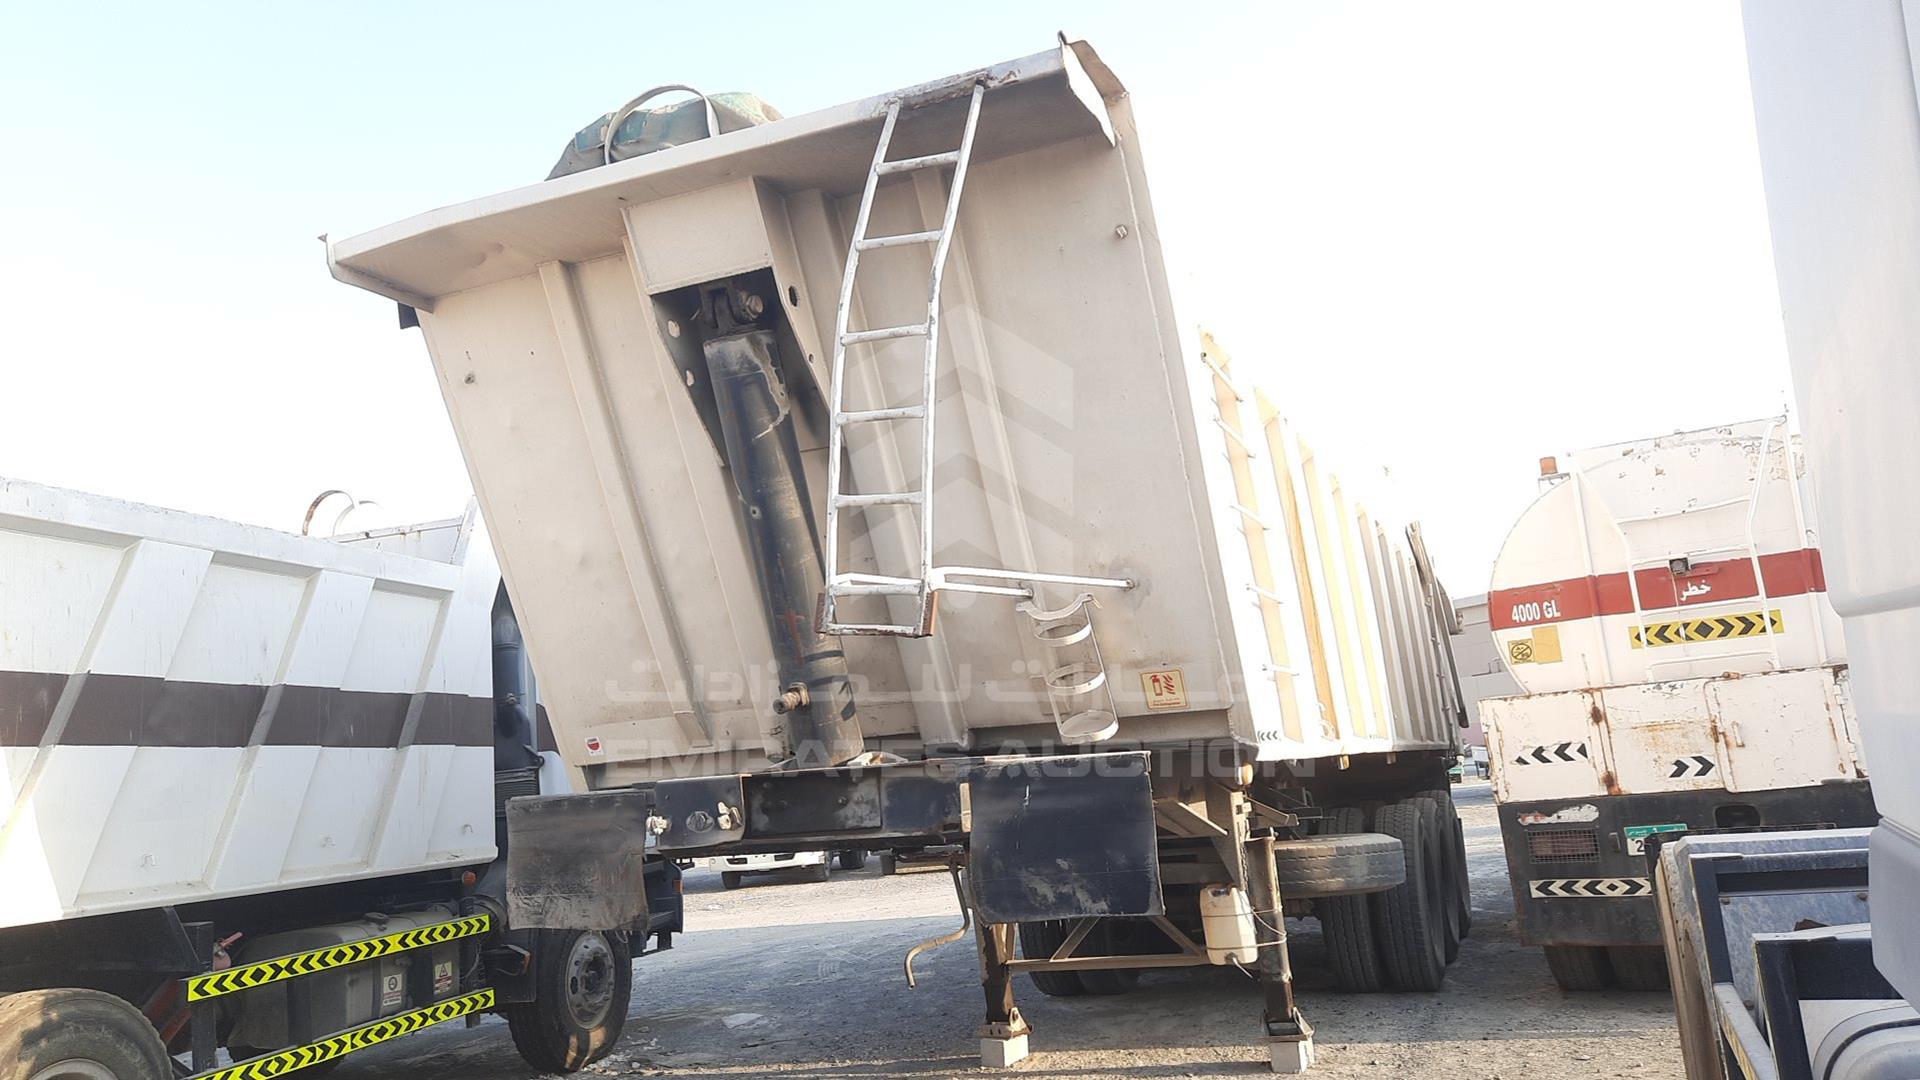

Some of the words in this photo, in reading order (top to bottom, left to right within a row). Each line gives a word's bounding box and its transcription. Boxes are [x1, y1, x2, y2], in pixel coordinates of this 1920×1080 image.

[1680, 579, 1711, 601] خطر
[1511, 602, 1541, 623] 4000
[1543, 599, 1561, 618] GL
